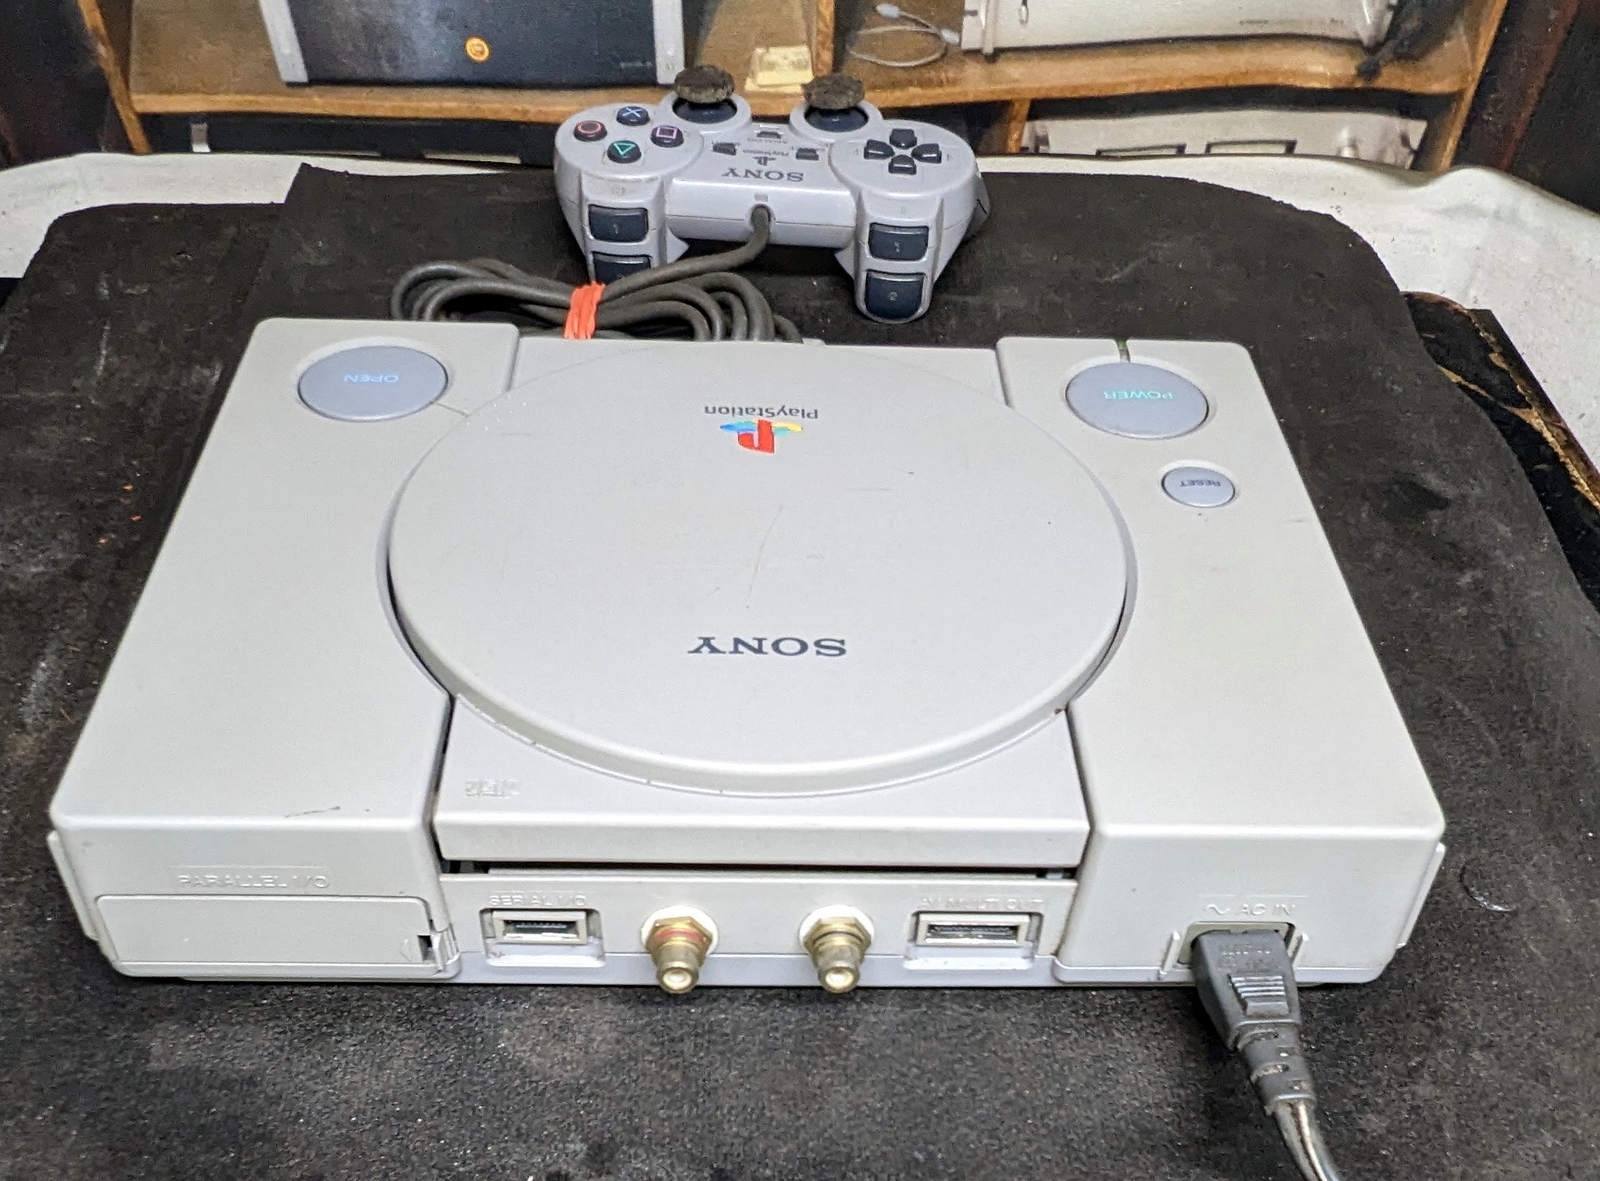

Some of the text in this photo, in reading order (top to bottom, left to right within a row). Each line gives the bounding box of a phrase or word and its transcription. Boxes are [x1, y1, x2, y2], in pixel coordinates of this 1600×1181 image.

[721, 167, 804, 182] SONY
[343, 373, 399, 383] OPEN
[1103, 389, 1173, 400] POWER
[703, 404, 819, 420] PlayStation
[1180, 479, 1221, 488] RESET
[687, 636, 847, 657] SONY
[177, 874, 330, 888] PARALLEL I/O
[489, 894, 553, 906] SERIAL
[1240, 903, 1267, 916] AC
